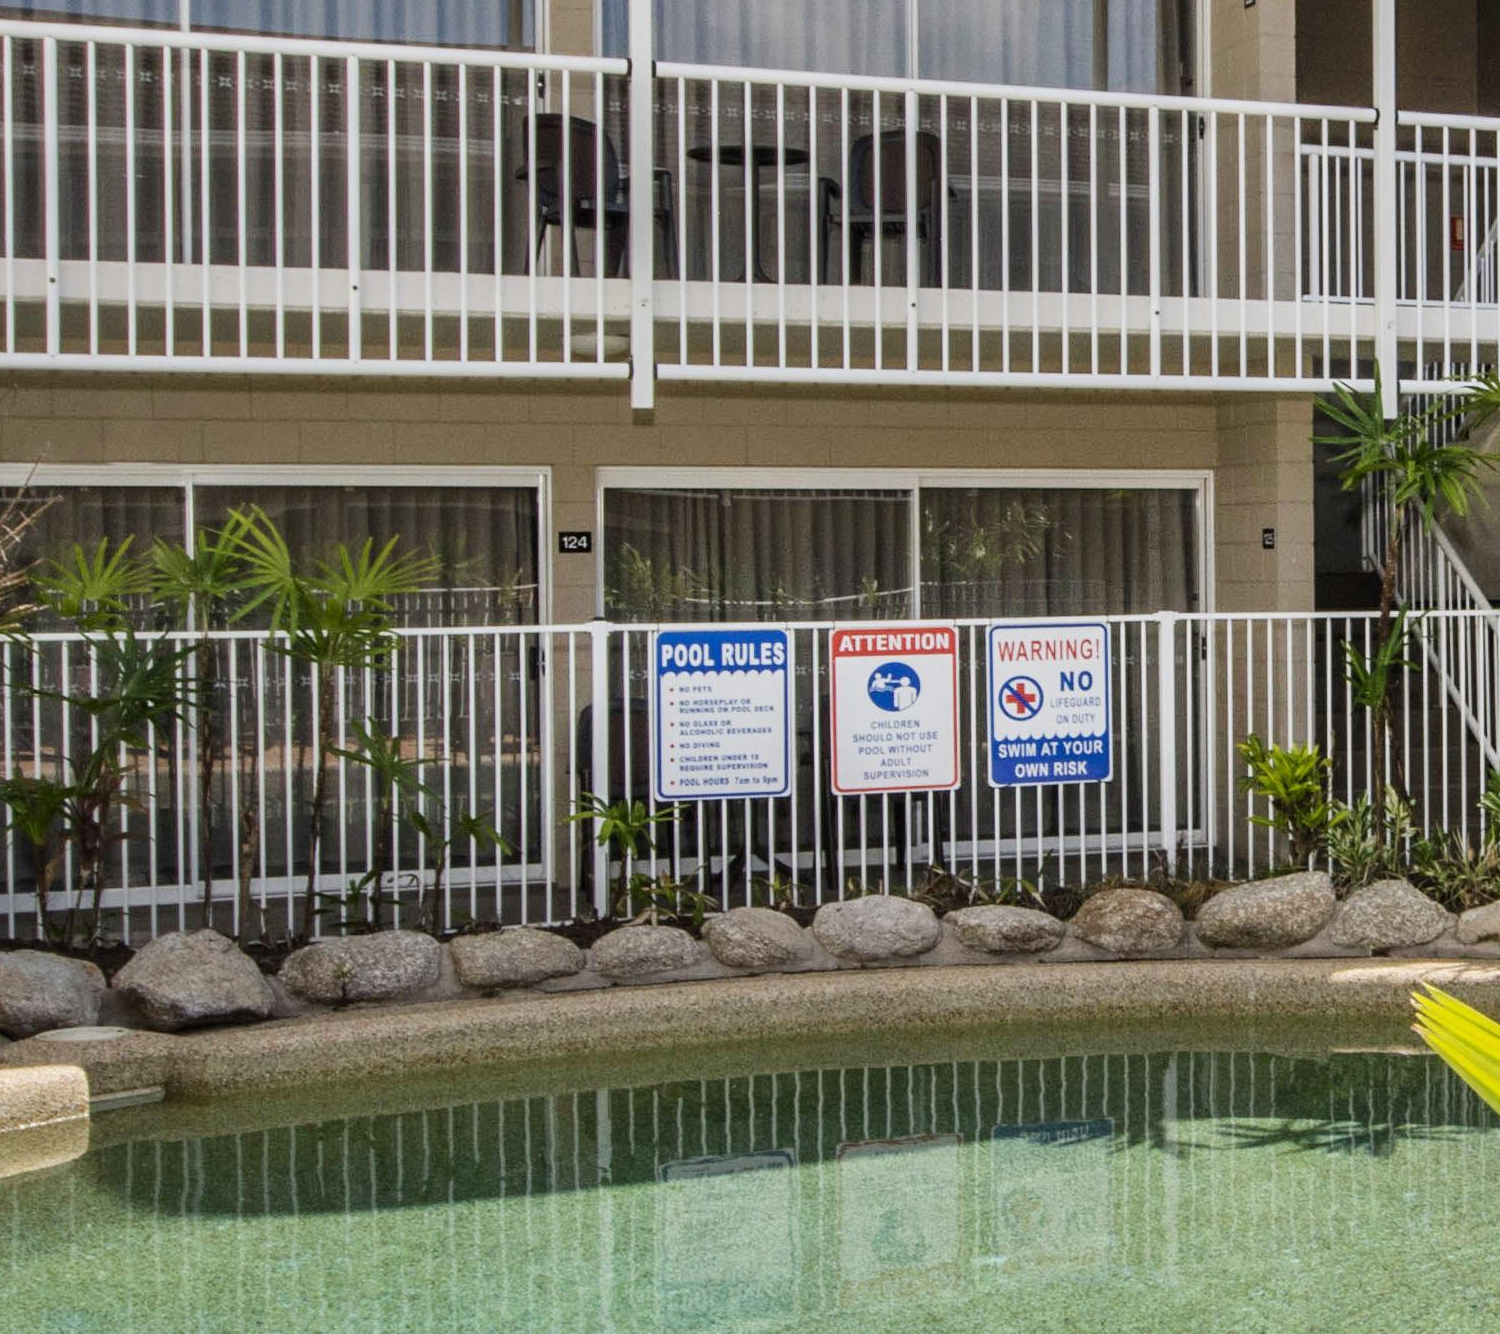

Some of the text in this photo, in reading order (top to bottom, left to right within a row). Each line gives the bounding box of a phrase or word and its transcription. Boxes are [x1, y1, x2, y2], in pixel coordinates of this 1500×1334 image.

[562, 535, 588, 549] 124
[838, 633, 950, 652] ATTENTION
[661, 642, 785, 667] POOL RULES
[997, 638, 1100, 662] WARNING!
[1059, 670, 1093, 692] NO
[1050, 697, 1101, 708] LIFEGUARD
[1056, 713, 1096, 724] ON DUTY
[871, 719, 921, 730] CHILDREN
[679, 727, 772, 736] ALCOHOLIC BEVERAGES
[852, 731, 939, 743] SHOULD NOT USE
[858, 744, 932, 756] POOL WITHOUT
[998, 740, 1103, 758] SWIM AT YOUR
[679, 755, 719, 763] CHILDREN
[880, 758, 911, 767] ADULT
[679, 763, 768, 772] REQUIRE SUPERVISION
[1014, 761, 1088, 778] OWN RISK
[863, 769, 929, 780] SUPERVISION
[679, 778, 701, 787] POOL
[702, 777, 730, 786] HOURS
[734, 777, 750, 785] 7am
